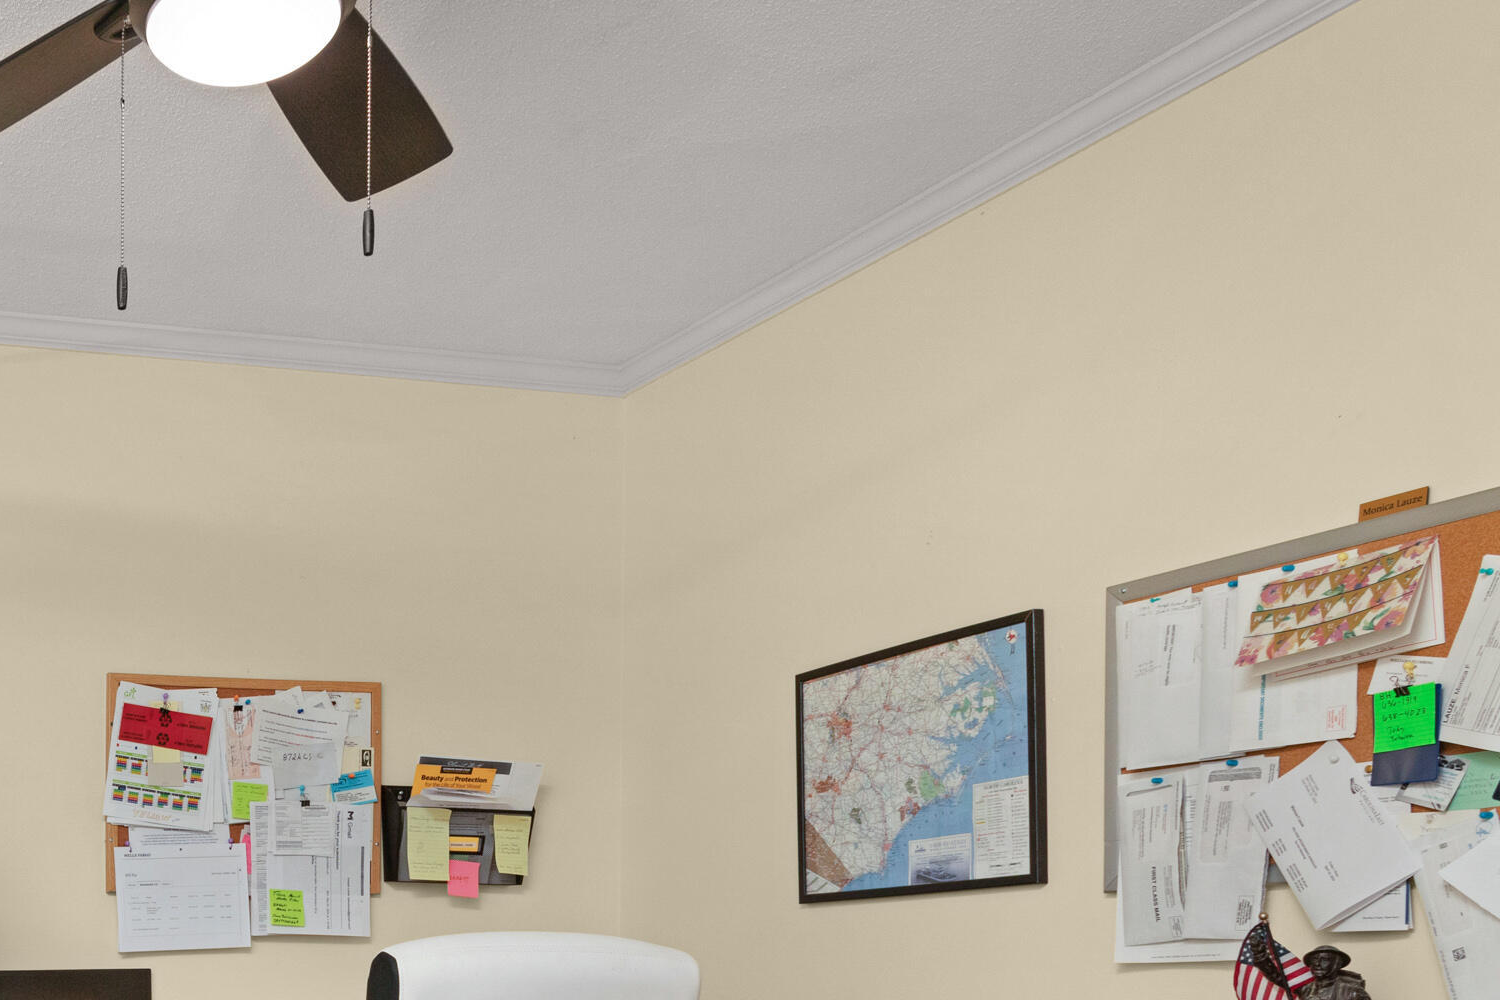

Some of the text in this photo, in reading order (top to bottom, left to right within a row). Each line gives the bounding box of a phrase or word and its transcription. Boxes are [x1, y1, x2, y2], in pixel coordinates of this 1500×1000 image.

[1363, 495, 1423, 516] Monica Lauze
[421, 774, 444, 782] Beauty
